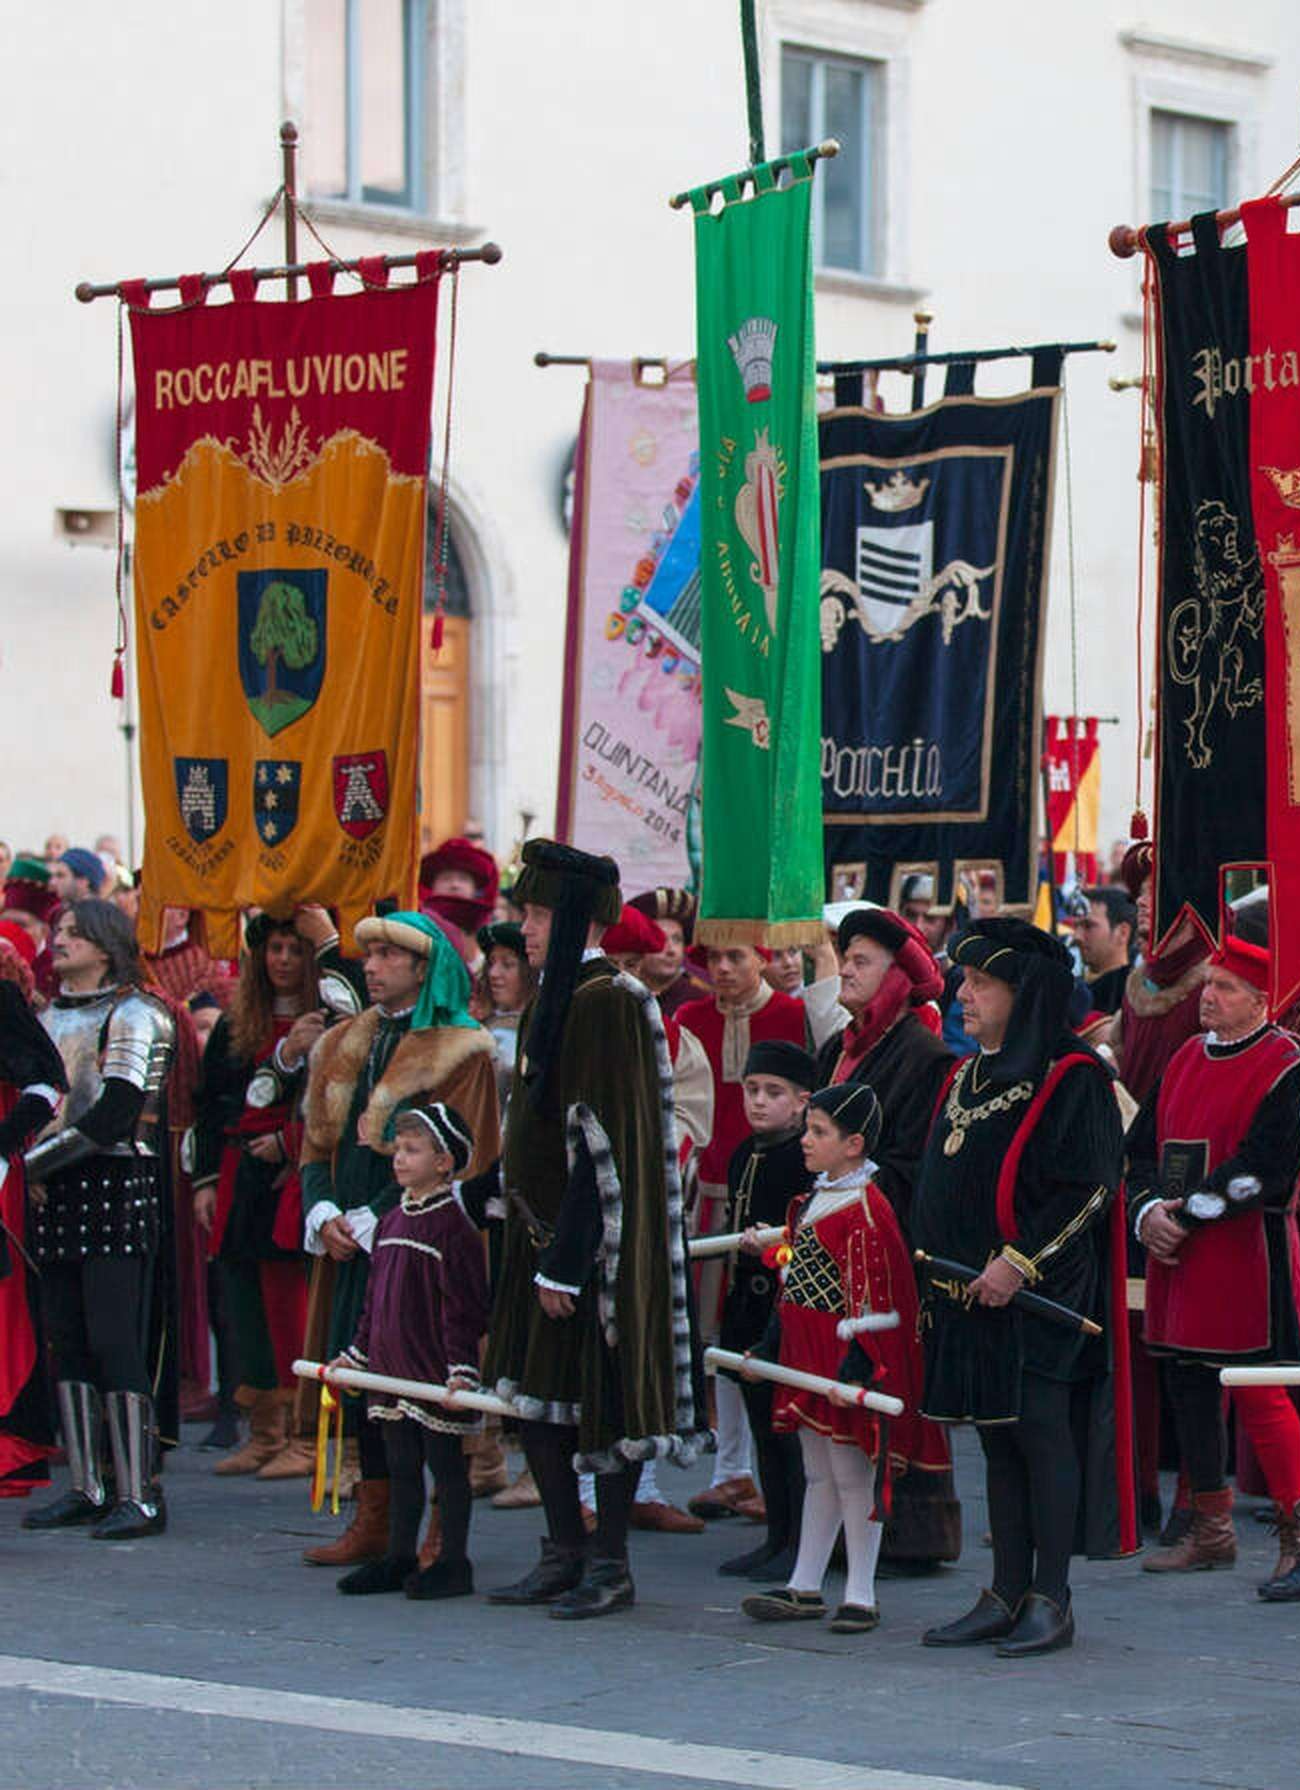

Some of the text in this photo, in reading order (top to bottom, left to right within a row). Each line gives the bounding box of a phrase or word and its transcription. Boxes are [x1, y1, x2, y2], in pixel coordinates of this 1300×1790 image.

[155, 349, 408, 411] ROCCAFLUVIONE
[1191, 346, 1299, 419] Porta
[581, 720, 696, 816] QUINTANA
[642, 807, 682, 844] 2014
